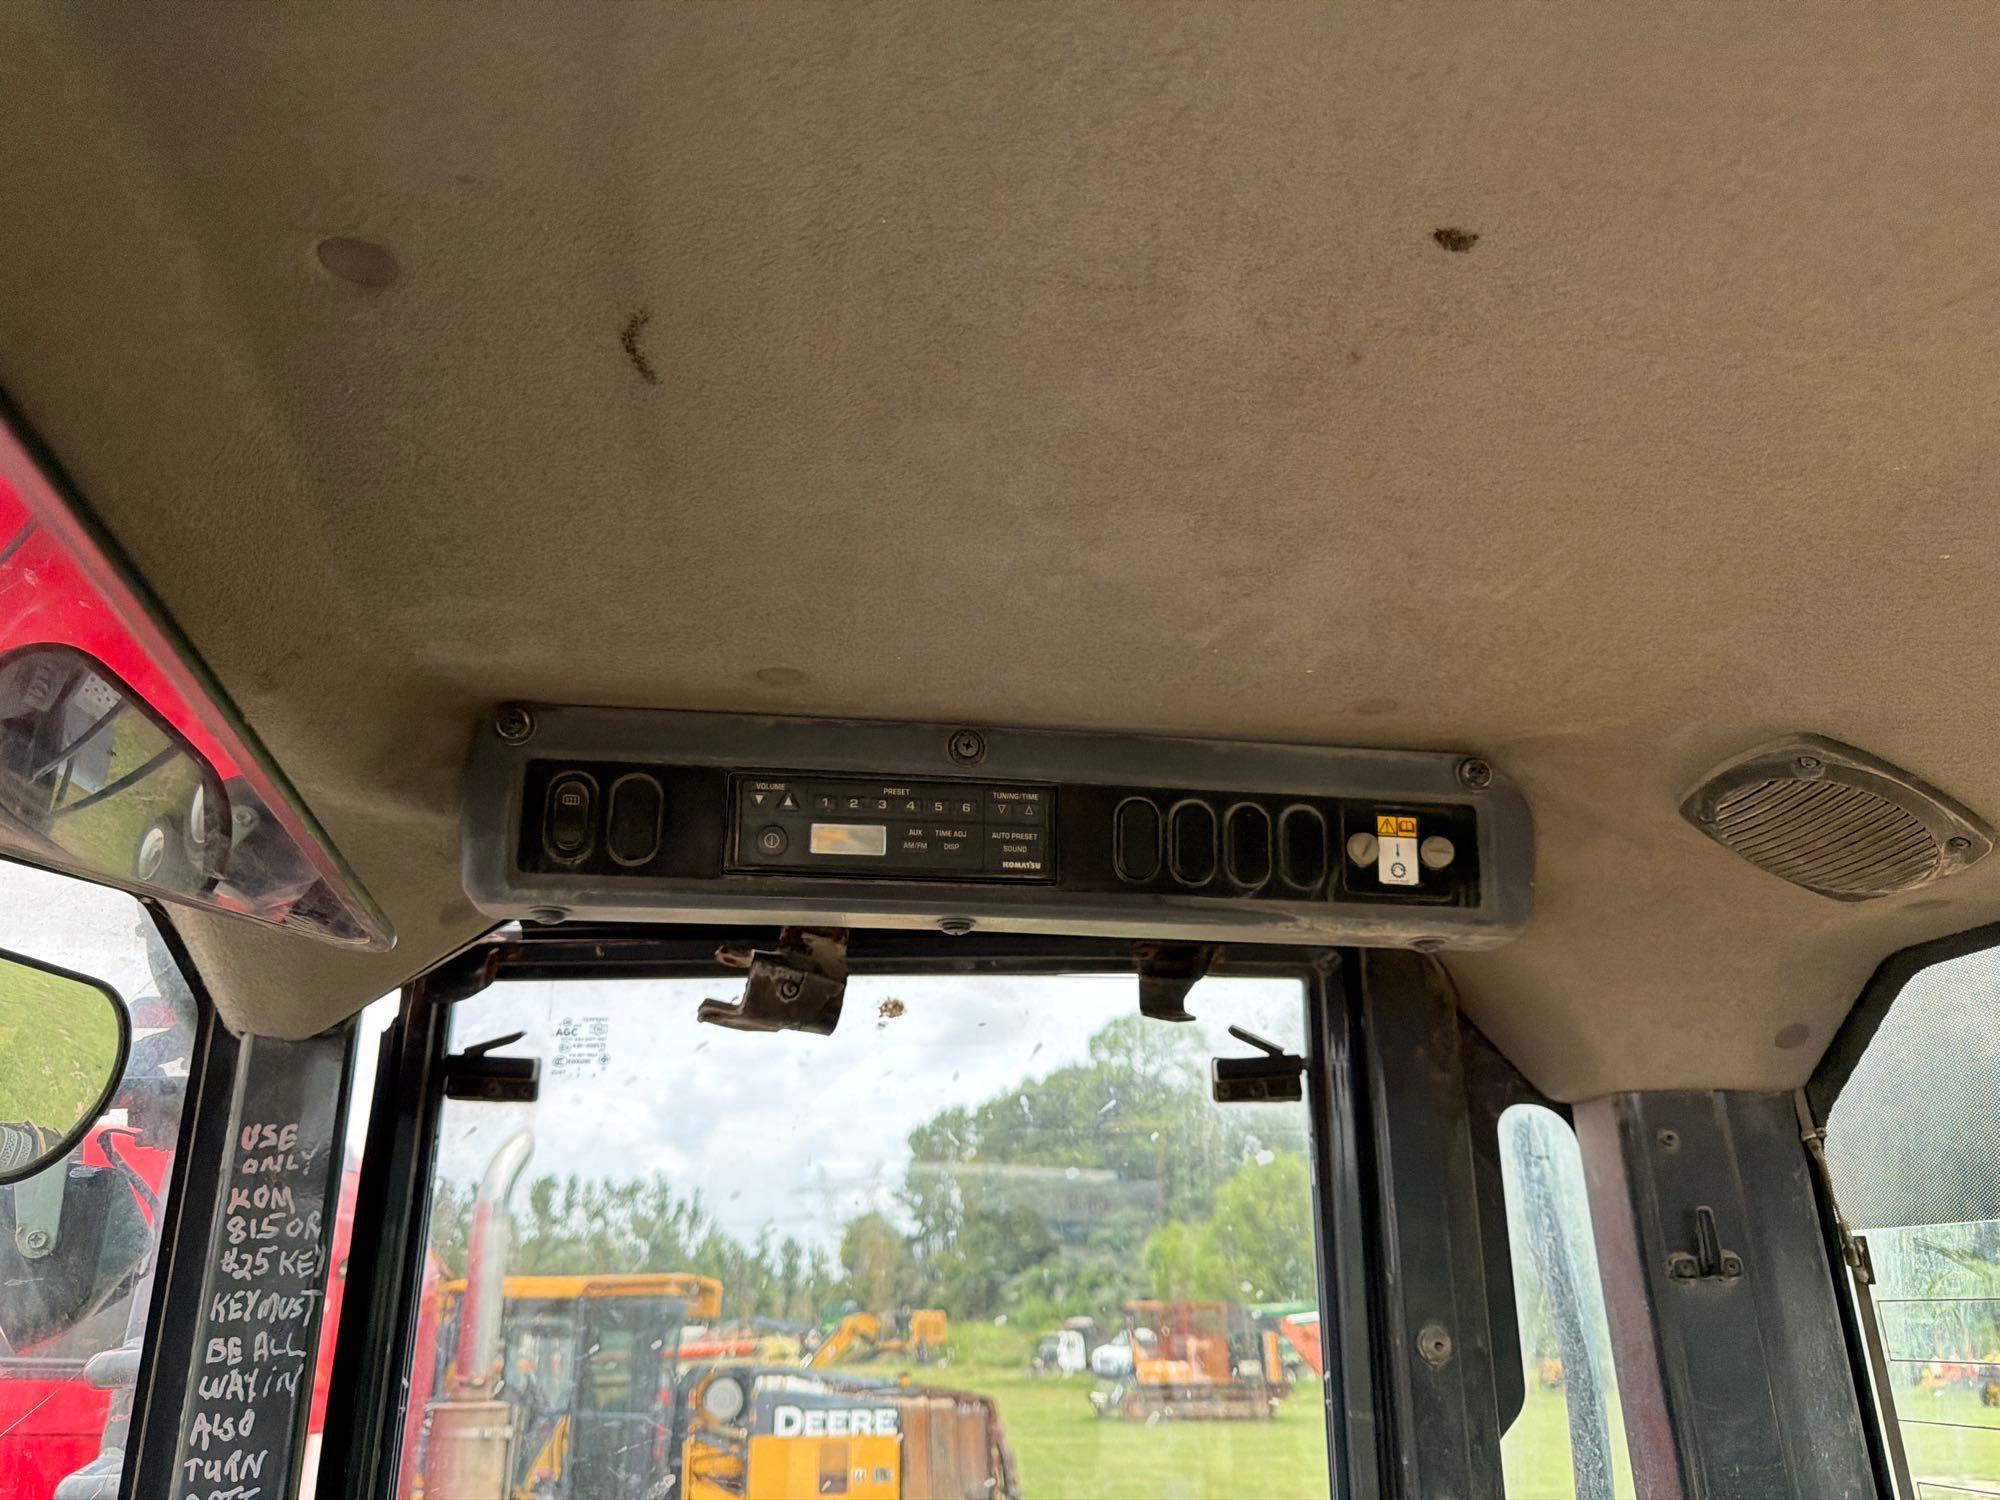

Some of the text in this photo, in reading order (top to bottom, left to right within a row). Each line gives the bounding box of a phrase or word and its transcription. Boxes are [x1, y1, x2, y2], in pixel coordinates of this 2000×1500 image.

[822, 797, 971, 813] 1 2 3 4 5 6
[883, 788, 911, 796] PRESET
[993, 792, 1039, 801] TUNING/TIME
[991, 832, 1011, 840] AUTO
[1003, 845, 1028, 853] SOUND
[1002, 861, 1042, 870] KOMATSU
[556, 1028, 578, 1036] AGC
[241, 1122, 299, 1152] USE
[227, 1184, 296, 1215] KOM
[226, 1210, 322, 1245] 815 OR
[210, 1288, 323, 1327] KEY MUST
[206, 1330, 307, 1366] BE ALL
[198, 1367, 259, 1403] WAY
[189, 1408, 256, 1451] ALSO
[773, 1404, 899, 1437] DEERE
[183, 1449, 269, 1482] TURN
